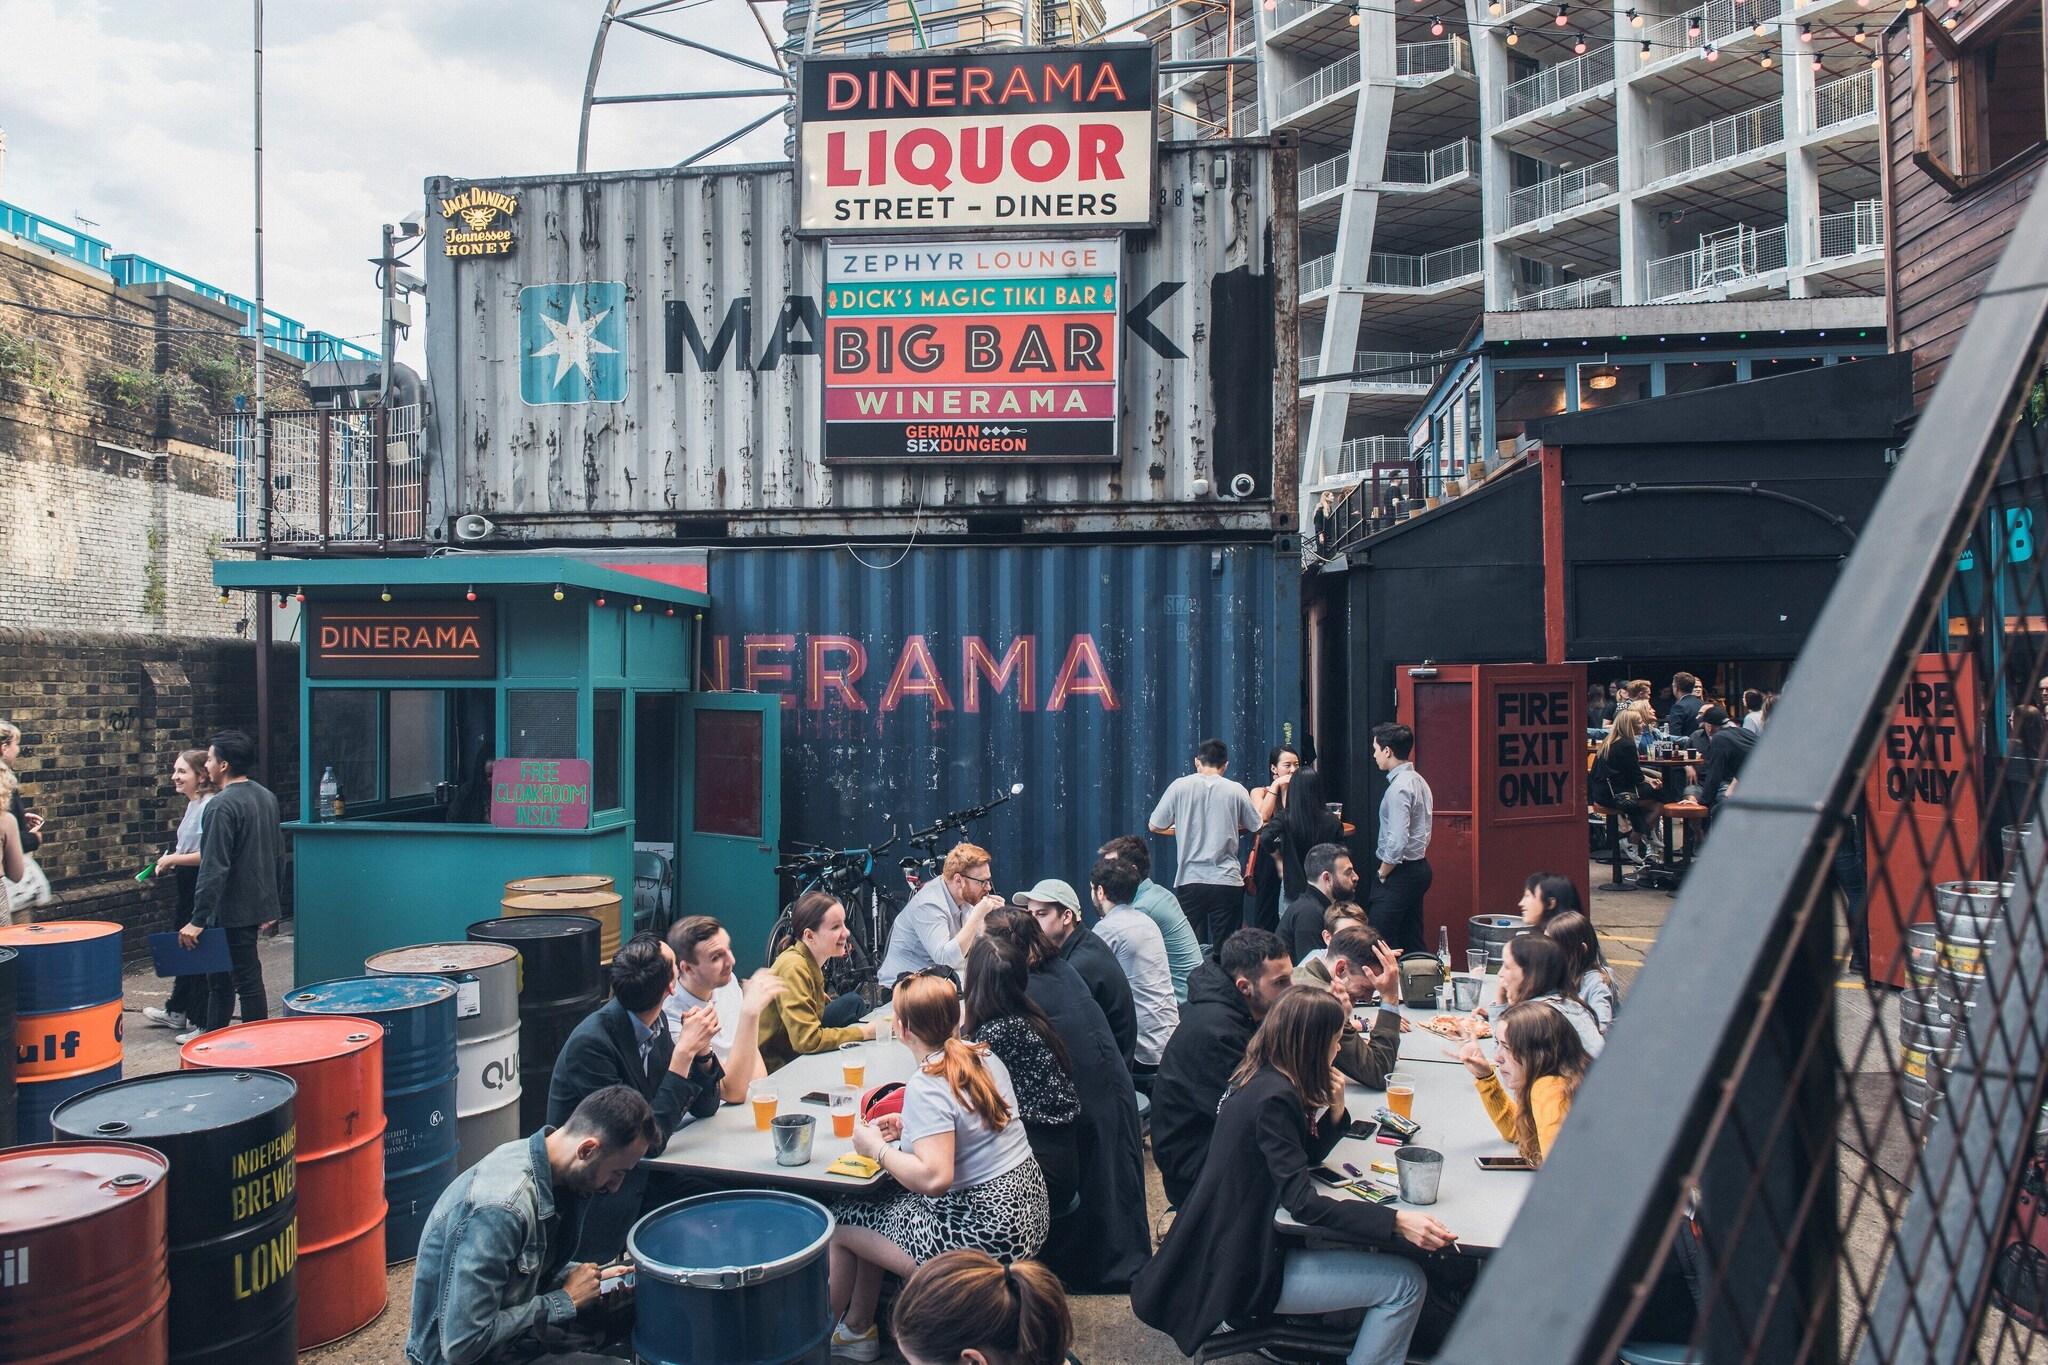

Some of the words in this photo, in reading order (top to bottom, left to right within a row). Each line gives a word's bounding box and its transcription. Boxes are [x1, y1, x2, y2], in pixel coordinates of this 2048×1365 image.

[827, 62, 1126, 111] DINERAMA
[826, 124, 1126, 192] LIQUOR
[442, 192, 471, 218] JACK
[834, 197, 955, 220] STREET
[996, 193, 1118, 217] DINERS
[445, 228, 511, 243] Tennessee
[445, 242, 511, 256] HONEY
[844, 253, 964, 273] ZEPHYR
[977, 250, 1097, 269] LOUNGE
[842, 289, 912, 309] DICK'S
[921, 288, 996, 307] MAGIC
[1003, 287, 1045, 306] TIKI
[1055, 286, 1097, 305] BAR
[833, 324, 945, 374] BIG
[964, 323, 1105, 373] BAR
[855, 390, 1087, 415] WINERAMA
[906, 424, 979, 439] GERMAN
[906, 438, 1027, 453] SEXDUNGEON
[321, 626, 480, 648] DINERAMA
[1498, 691, 1569, 727] FIRE
[1498, 732, 1569, 767] EXIT
[1886, 725, 1956, 762] EXIT
[521, 761, 560, 782] FREE
[496, 784, 586, 804] CLOAKROOM
[1500, 771, 1569, 807] ONLY
[1886, 767, 1959, 804] ONLY
[516, 805, 561, 826] INSIDE
